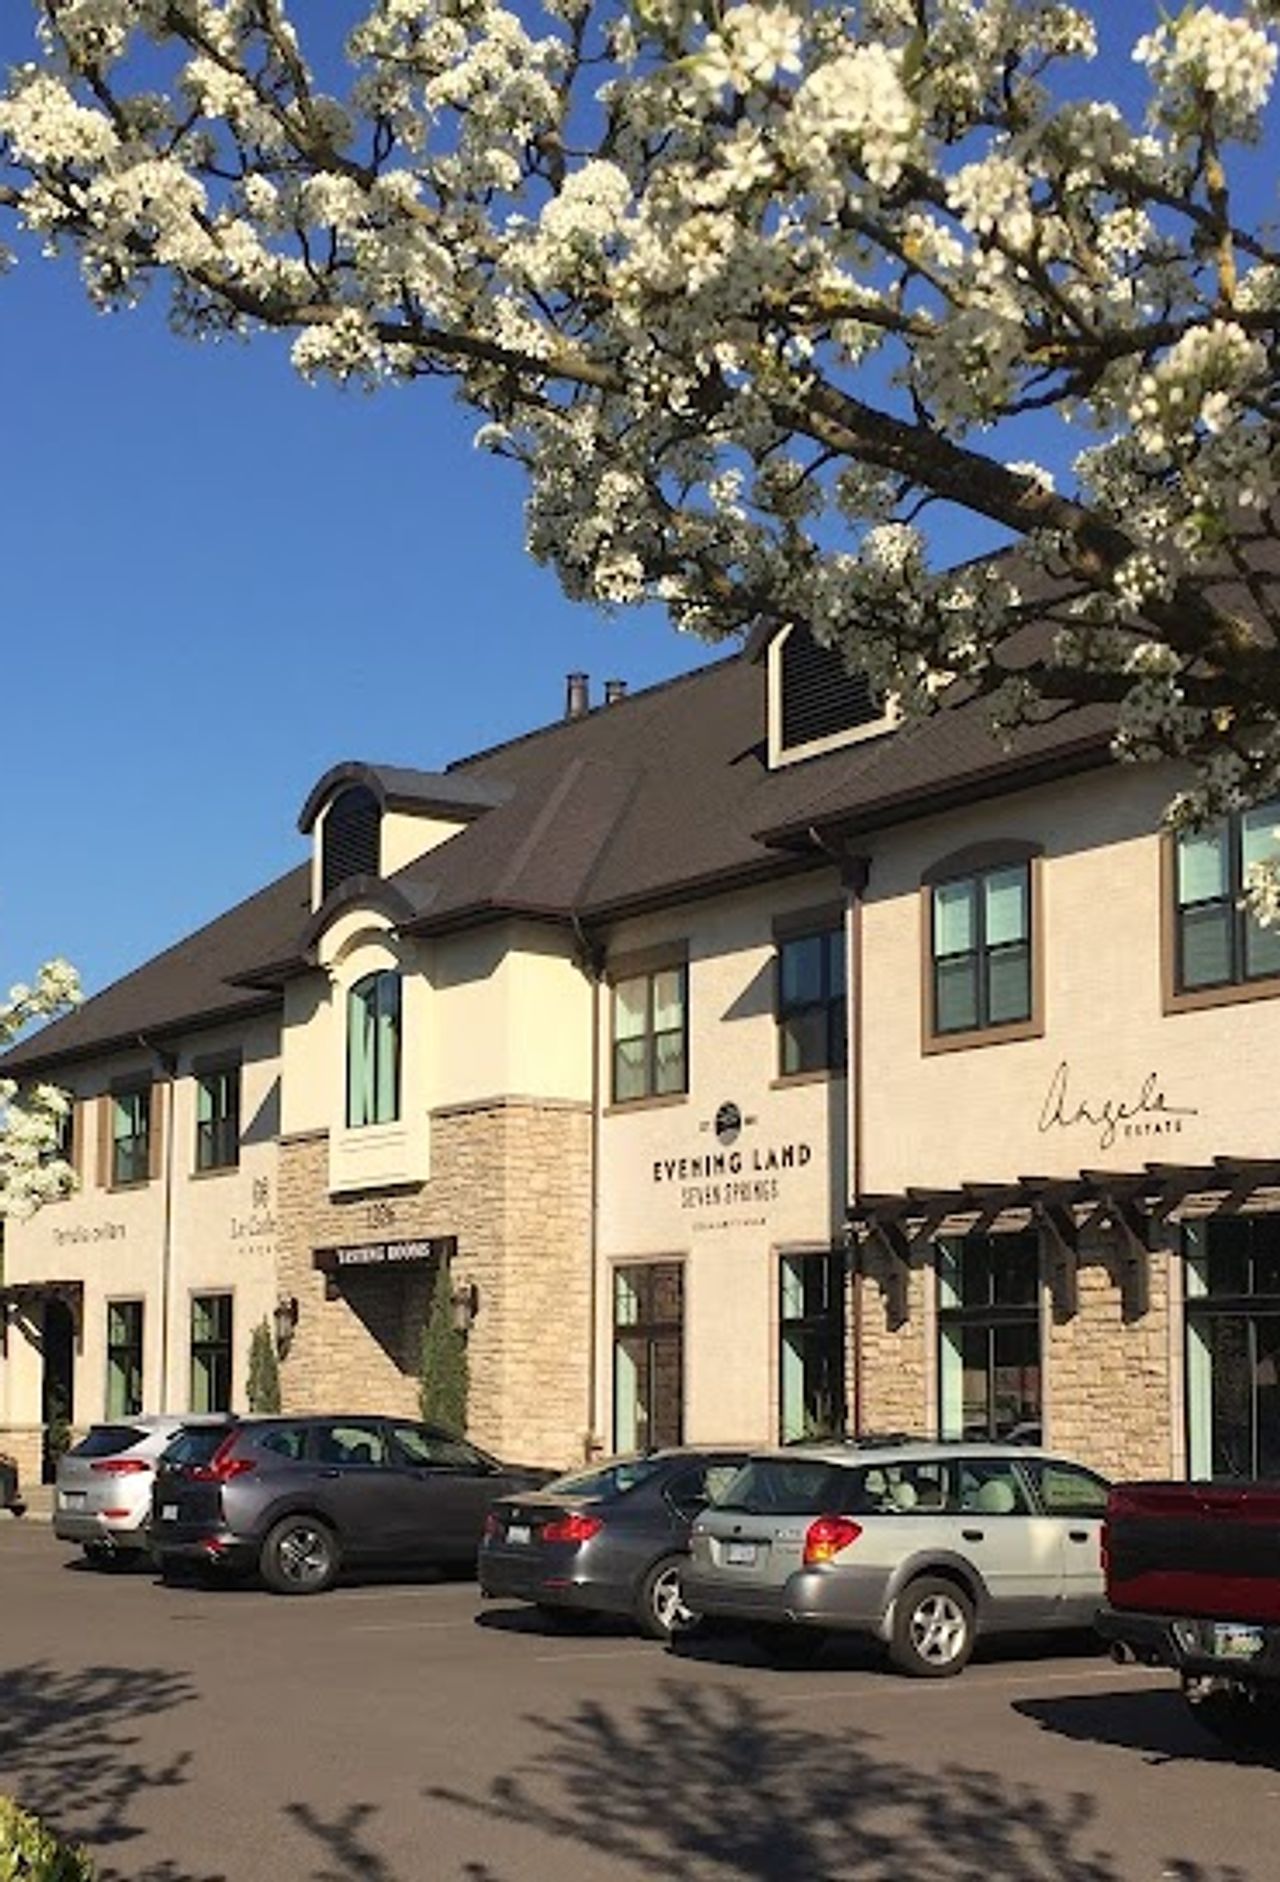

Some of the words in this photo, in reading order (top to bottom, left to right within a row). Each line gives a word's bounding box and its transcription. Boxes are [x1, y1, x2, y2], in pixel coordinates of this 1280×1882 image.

[1124, 1119, 1182, 1137] ESTATE
[653, 1152, 742, 1182] EVENING
[753, 1144, 812, 1172] LAND
[681, 1183, 721, 1209] SEVEN
[725, 1178, 779, 1205] SPRINGS
[387, 1241, 431, 1261] ROOMS
